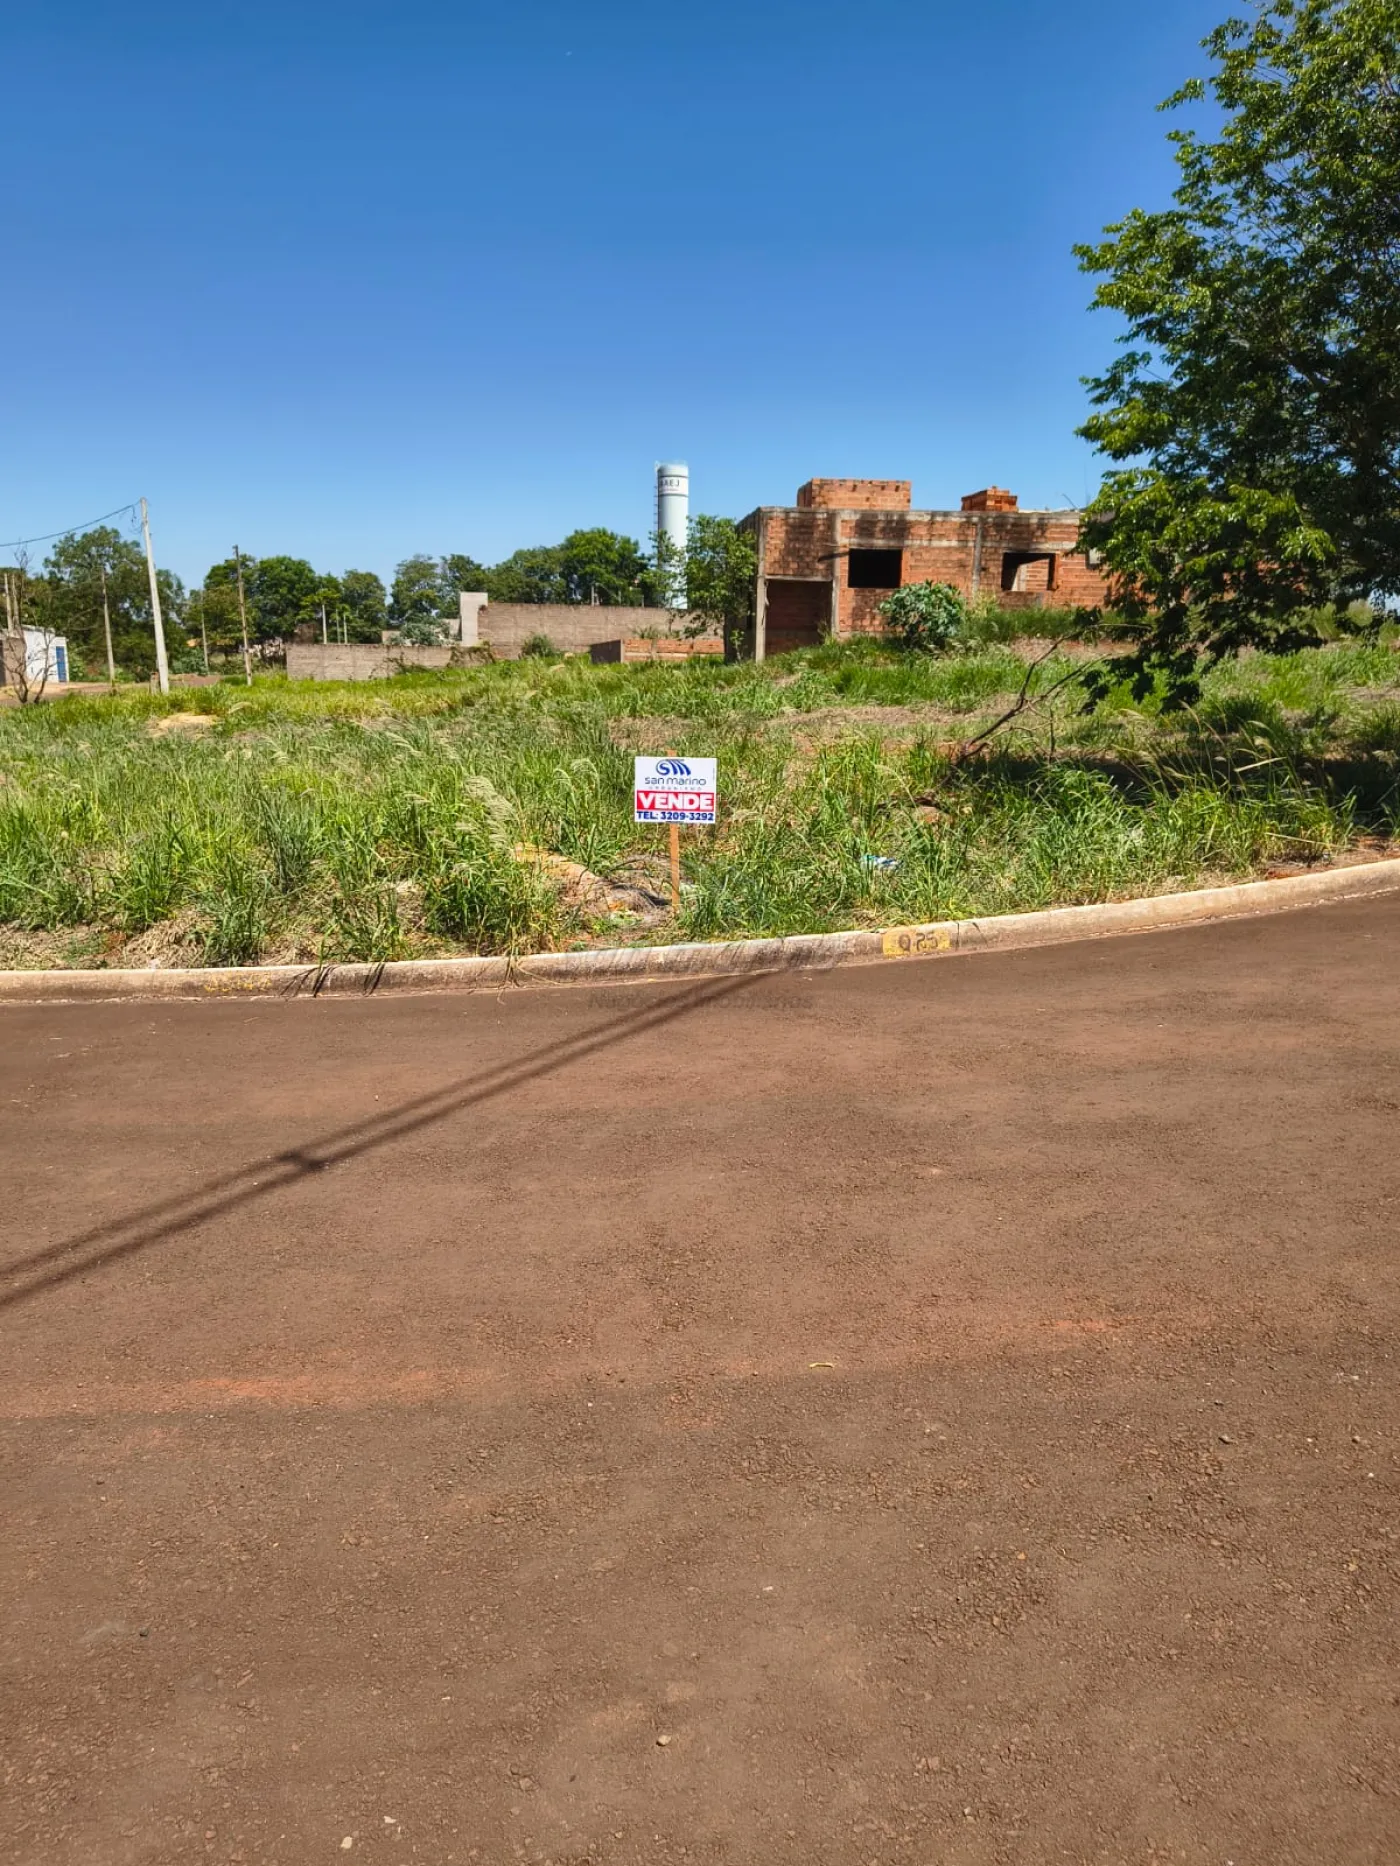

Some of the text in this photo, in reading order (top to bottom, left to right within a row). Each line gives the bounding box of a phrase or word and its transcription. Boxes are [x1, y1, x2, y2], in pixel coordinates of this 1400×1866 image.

[644, 776, 707, 786] san marino
[637, 793, 713, 811] VENDE
[660, 812, 714, 821] 3209-3292
